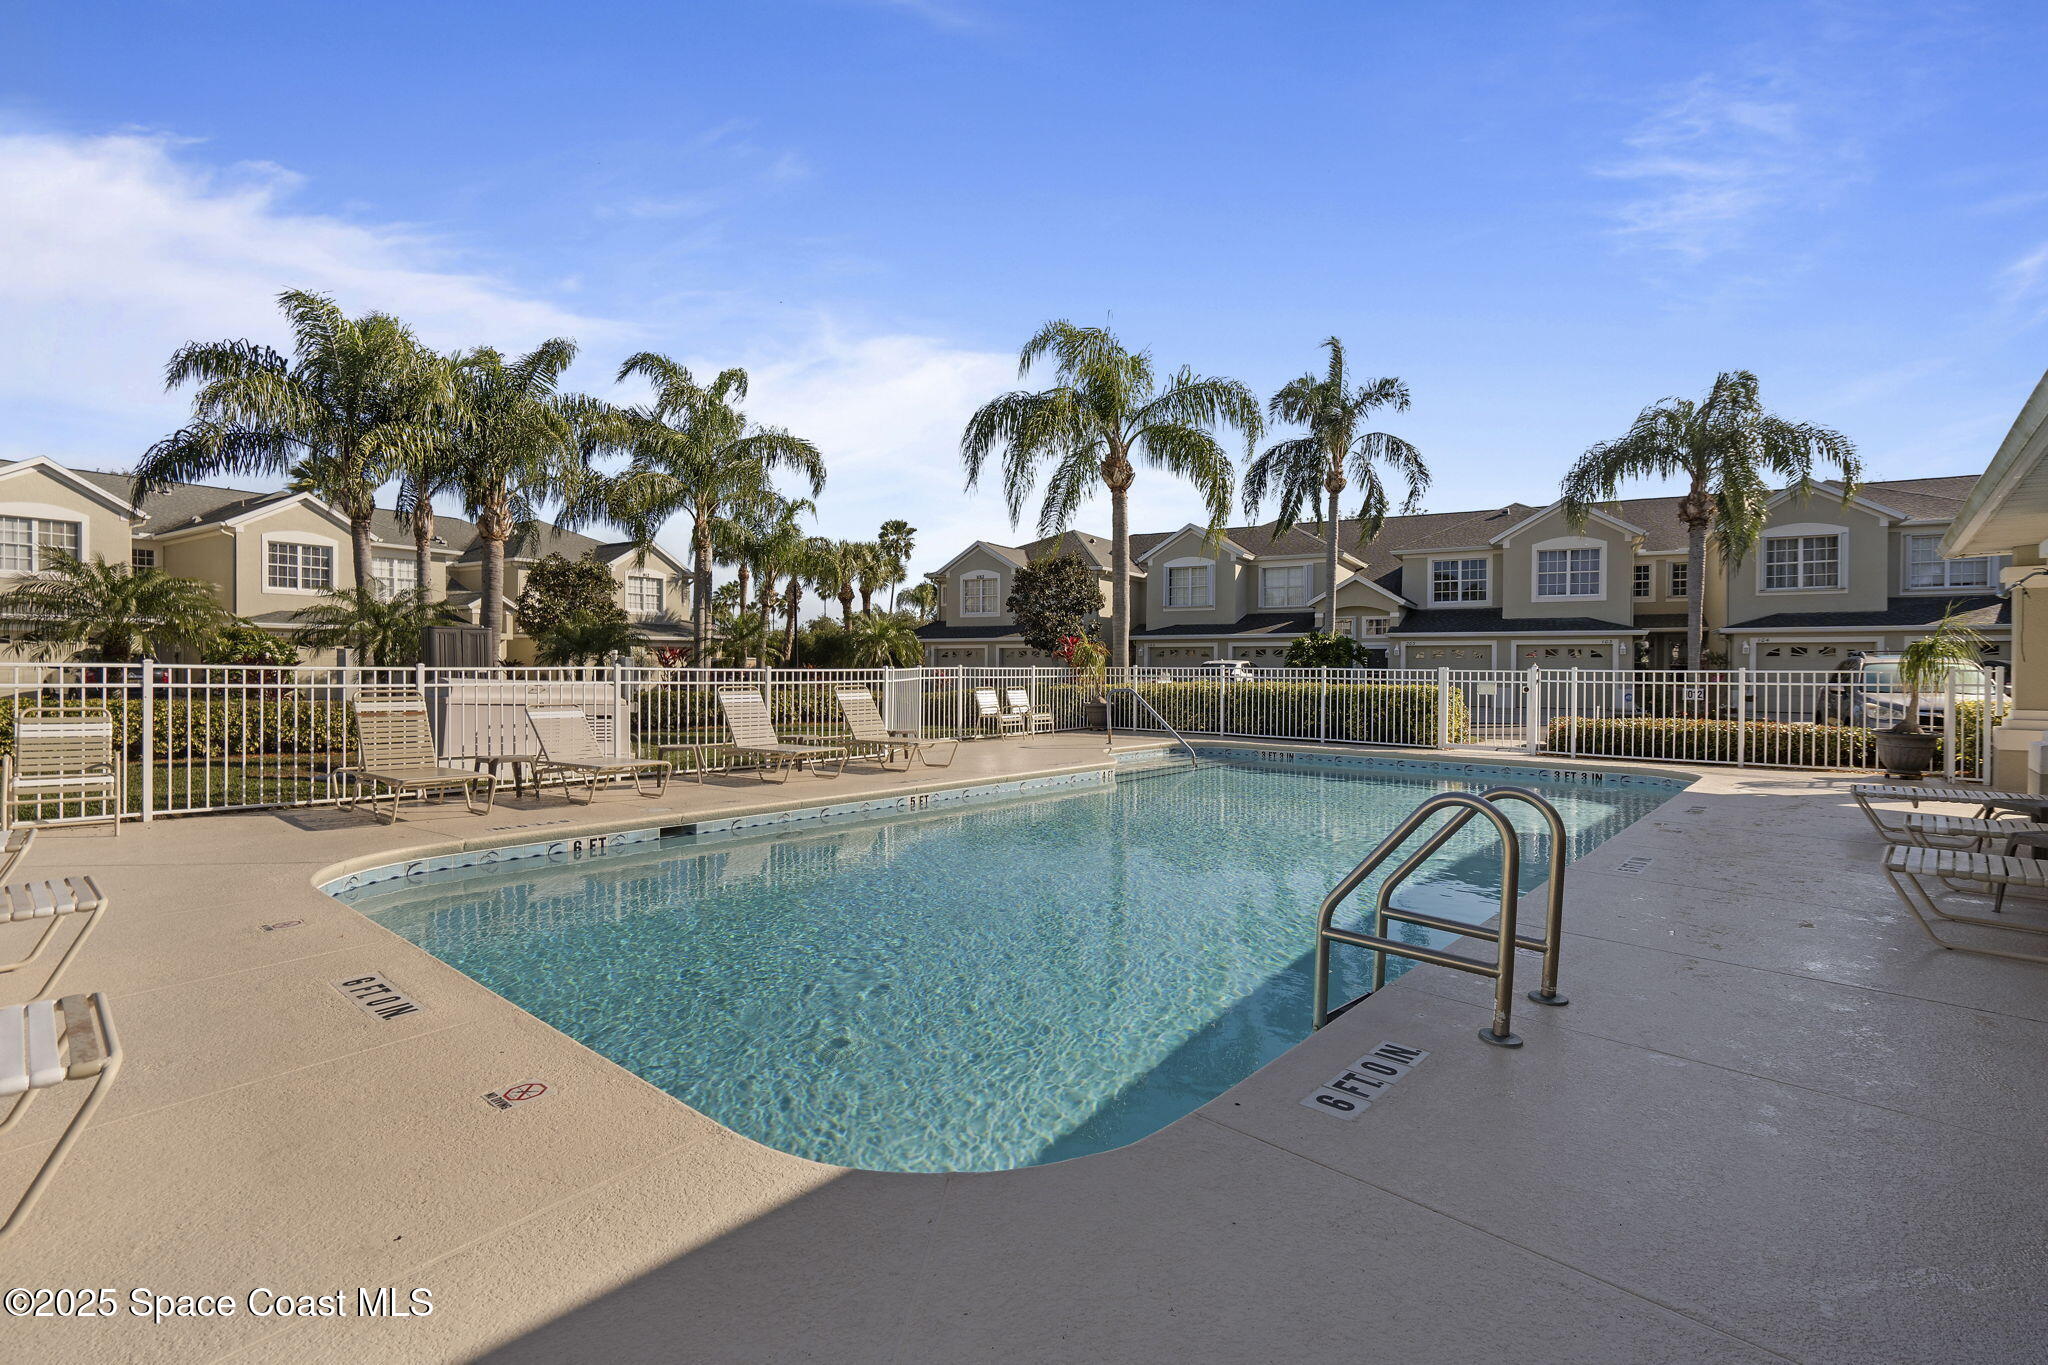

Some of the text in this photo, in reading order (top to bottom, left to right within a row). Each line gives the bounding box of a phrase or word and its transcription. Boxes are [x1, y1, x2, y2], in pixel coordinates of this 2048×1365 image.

[1261, 751, 1266, 759] 3
[1286, 752, 1294, 761] IN
[1554, 771, 1560, 779] 3
[1581, 772, 1587, 780] 3
[1592, 773, 1603, 781] IN
[910, 796, 916, 806] 5
[573, 837, 607, 852] 6 FT
[342, 977, 376, 986] 6
[1315, 1094, 1355, 1111] 6
